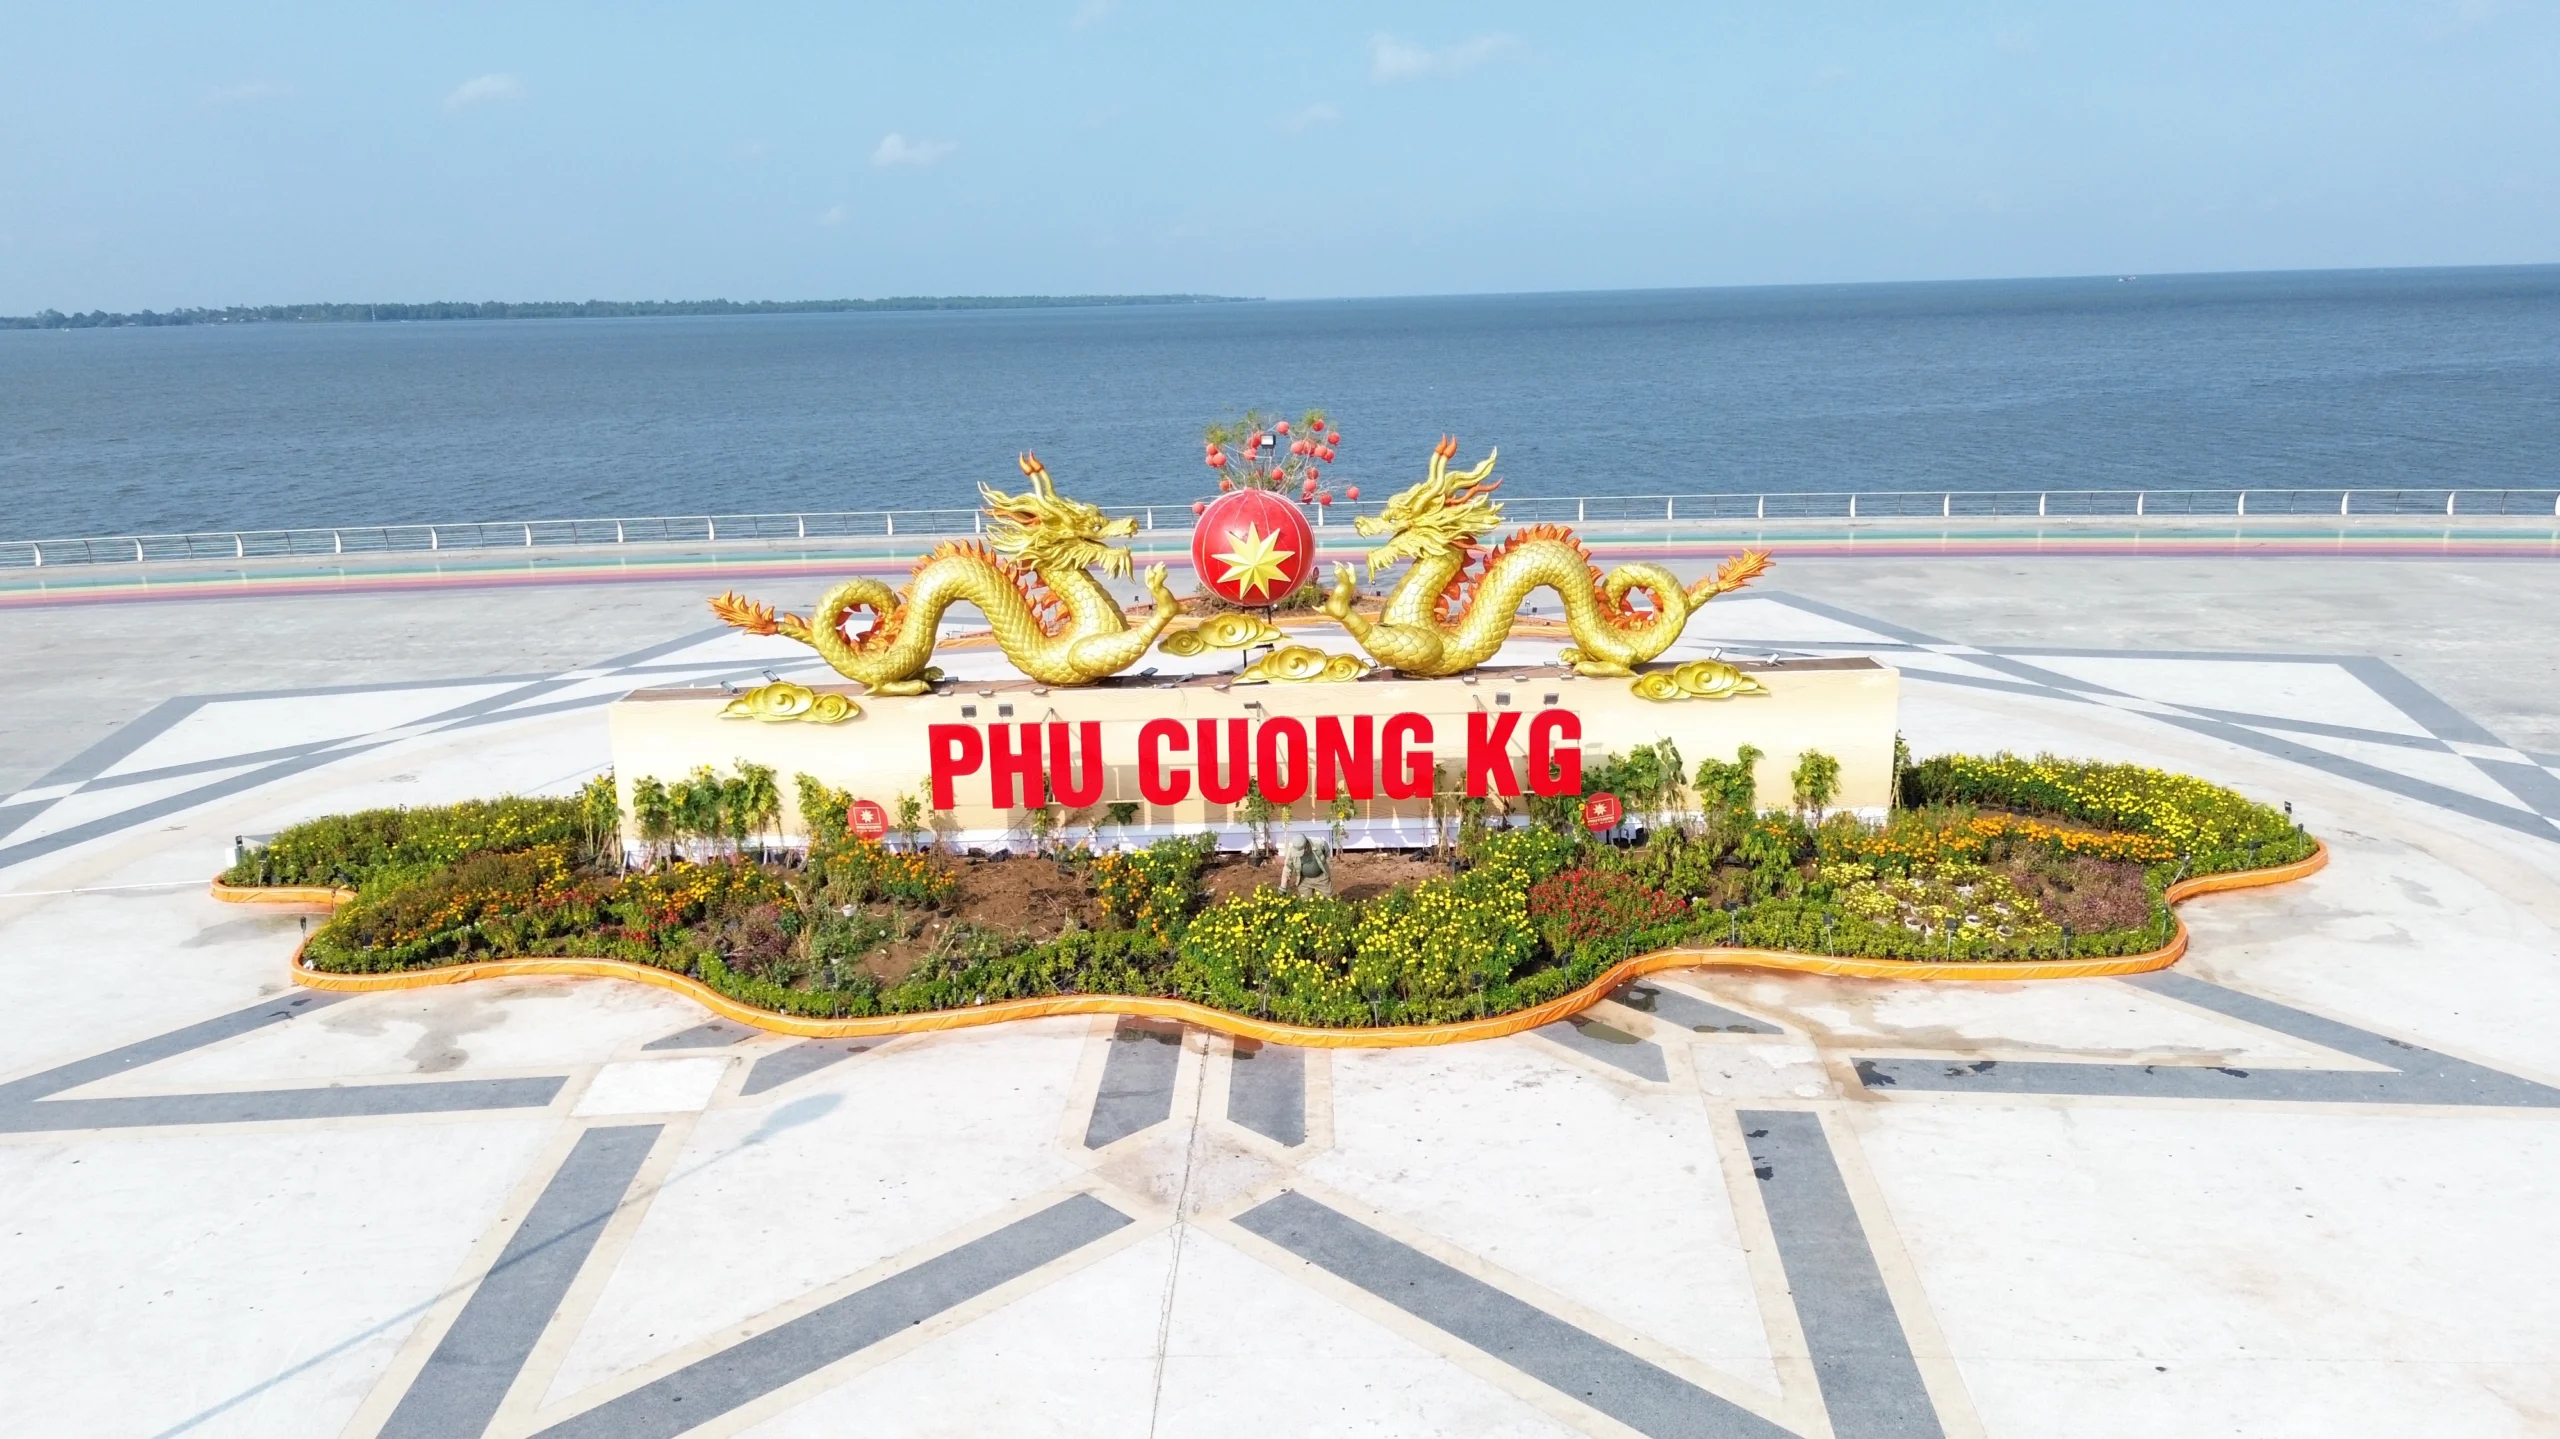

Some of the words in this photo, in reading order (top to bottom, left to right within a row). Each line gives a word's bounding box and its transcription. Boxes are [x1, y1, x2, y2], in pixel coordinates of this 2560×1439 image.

[928, 721, 1104, 811] PHU
[1138, 712, 1435, 806] CUONG
[1466, 709, 1583, 799] KG
